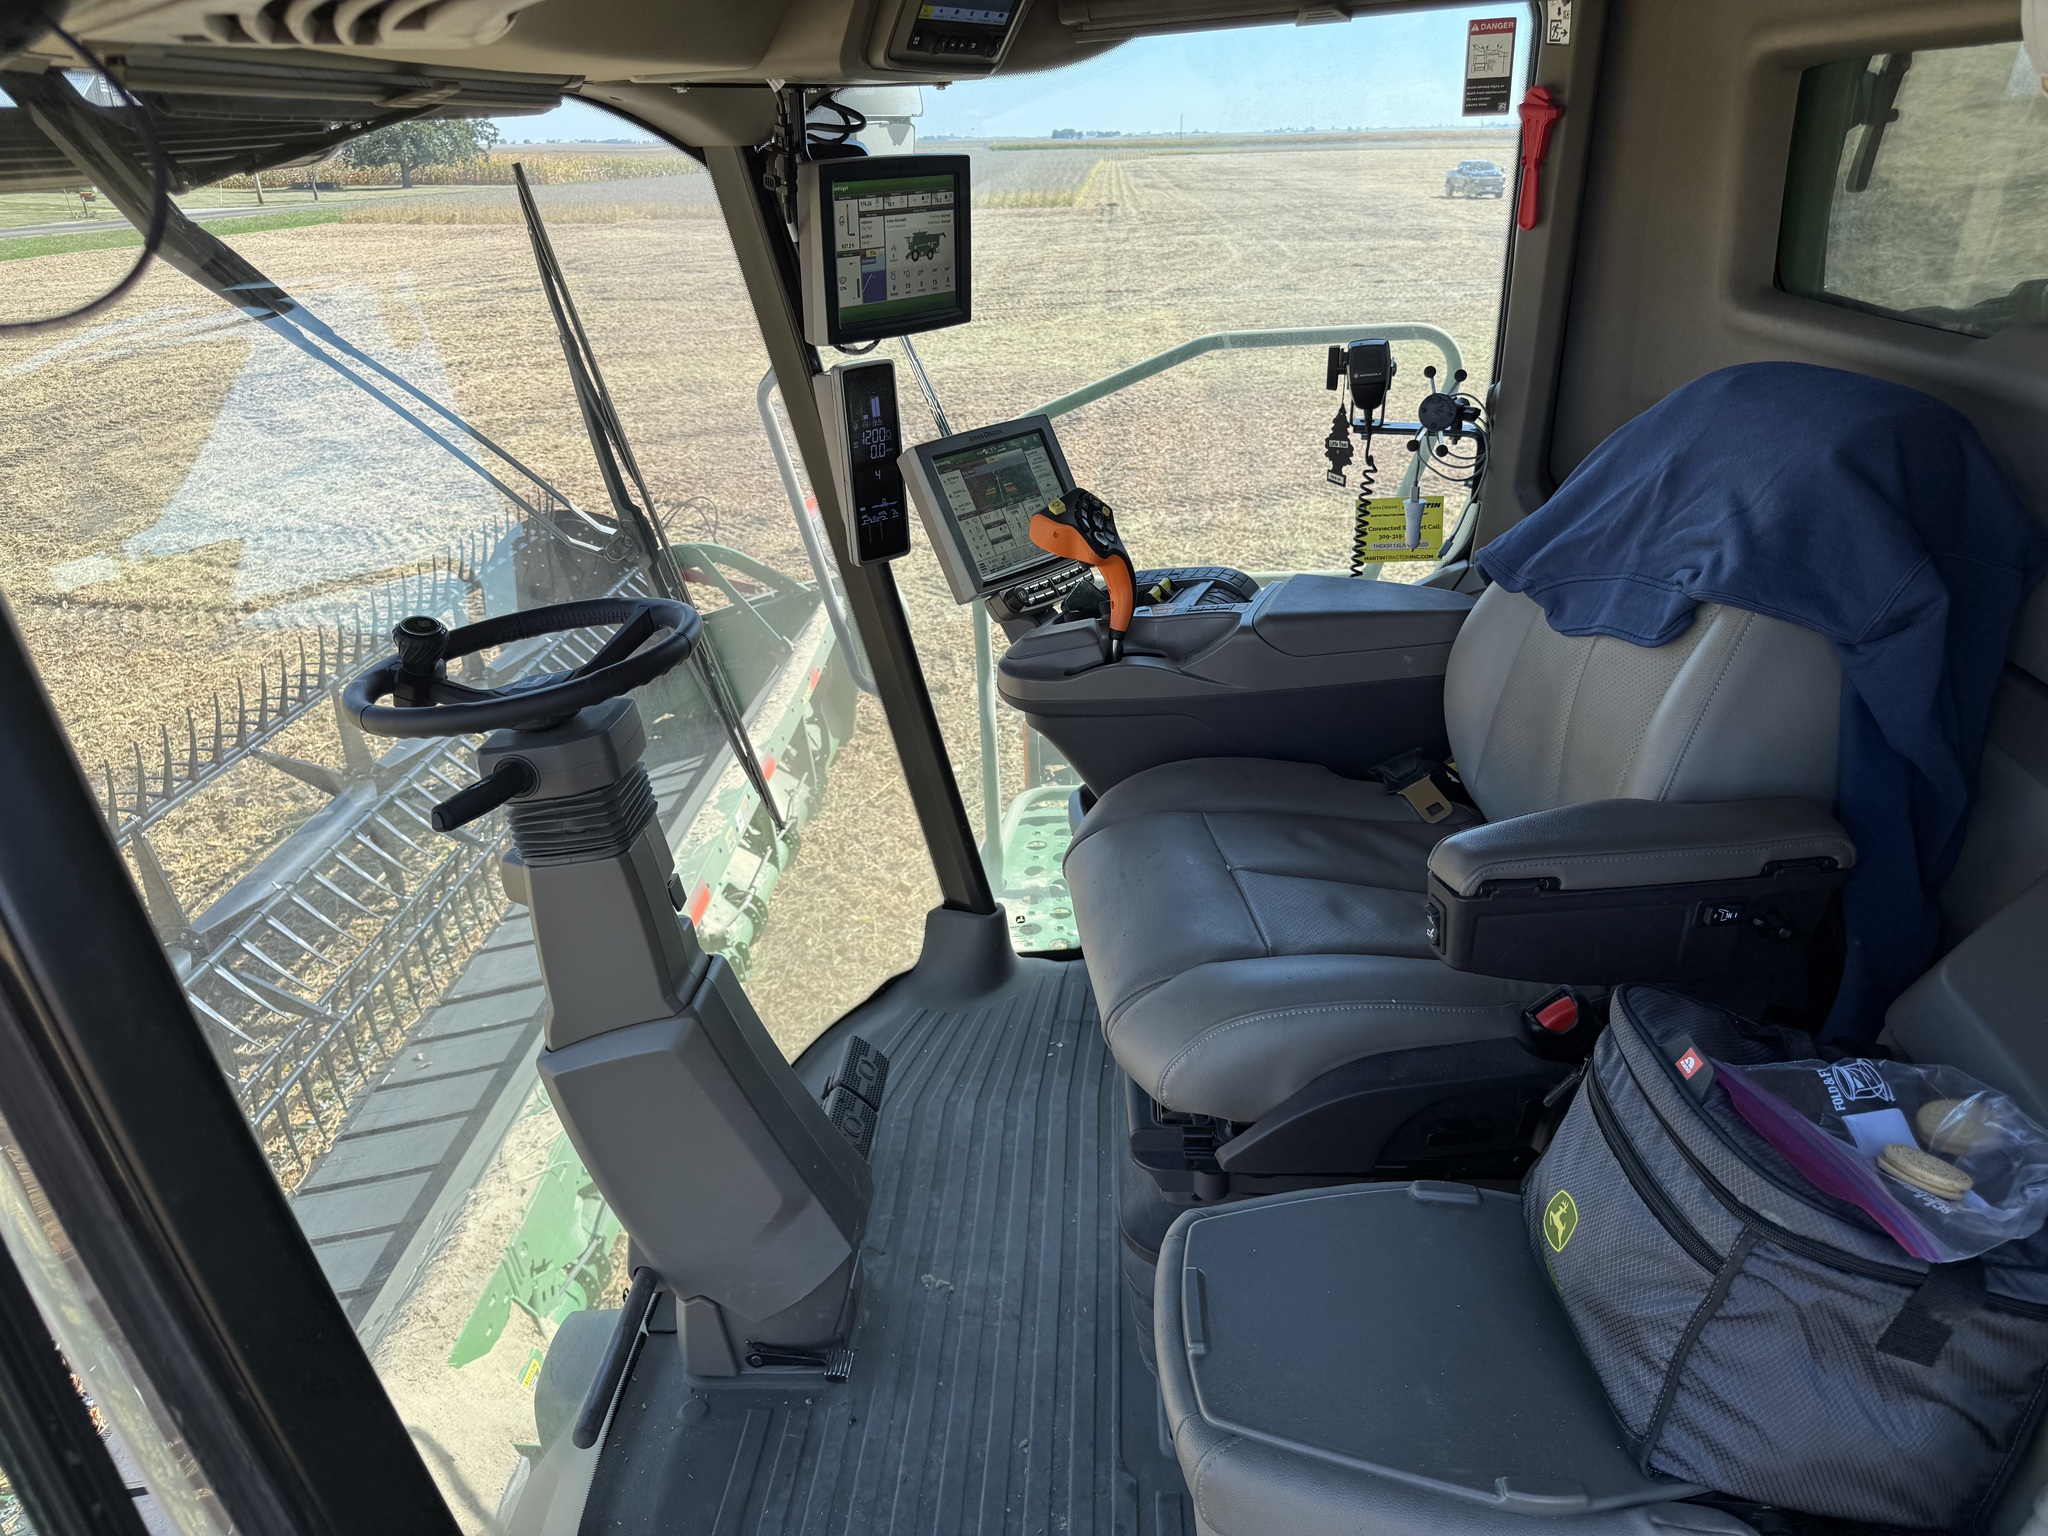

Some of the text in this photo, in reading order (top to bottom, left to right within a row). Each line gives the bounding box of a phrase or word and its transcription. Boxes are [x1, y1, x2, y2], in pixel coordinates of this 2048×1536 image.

[1480, 22, 1514, 31] DANGER
[862, 427, 885, 445] 1200
[969, 434, 984, 442] JOHN
[871, 443, 885, 459] 0.0
[1823, 1077, 1835, 1085] &
[1827, 1086, 1846, 1112] FOLD
